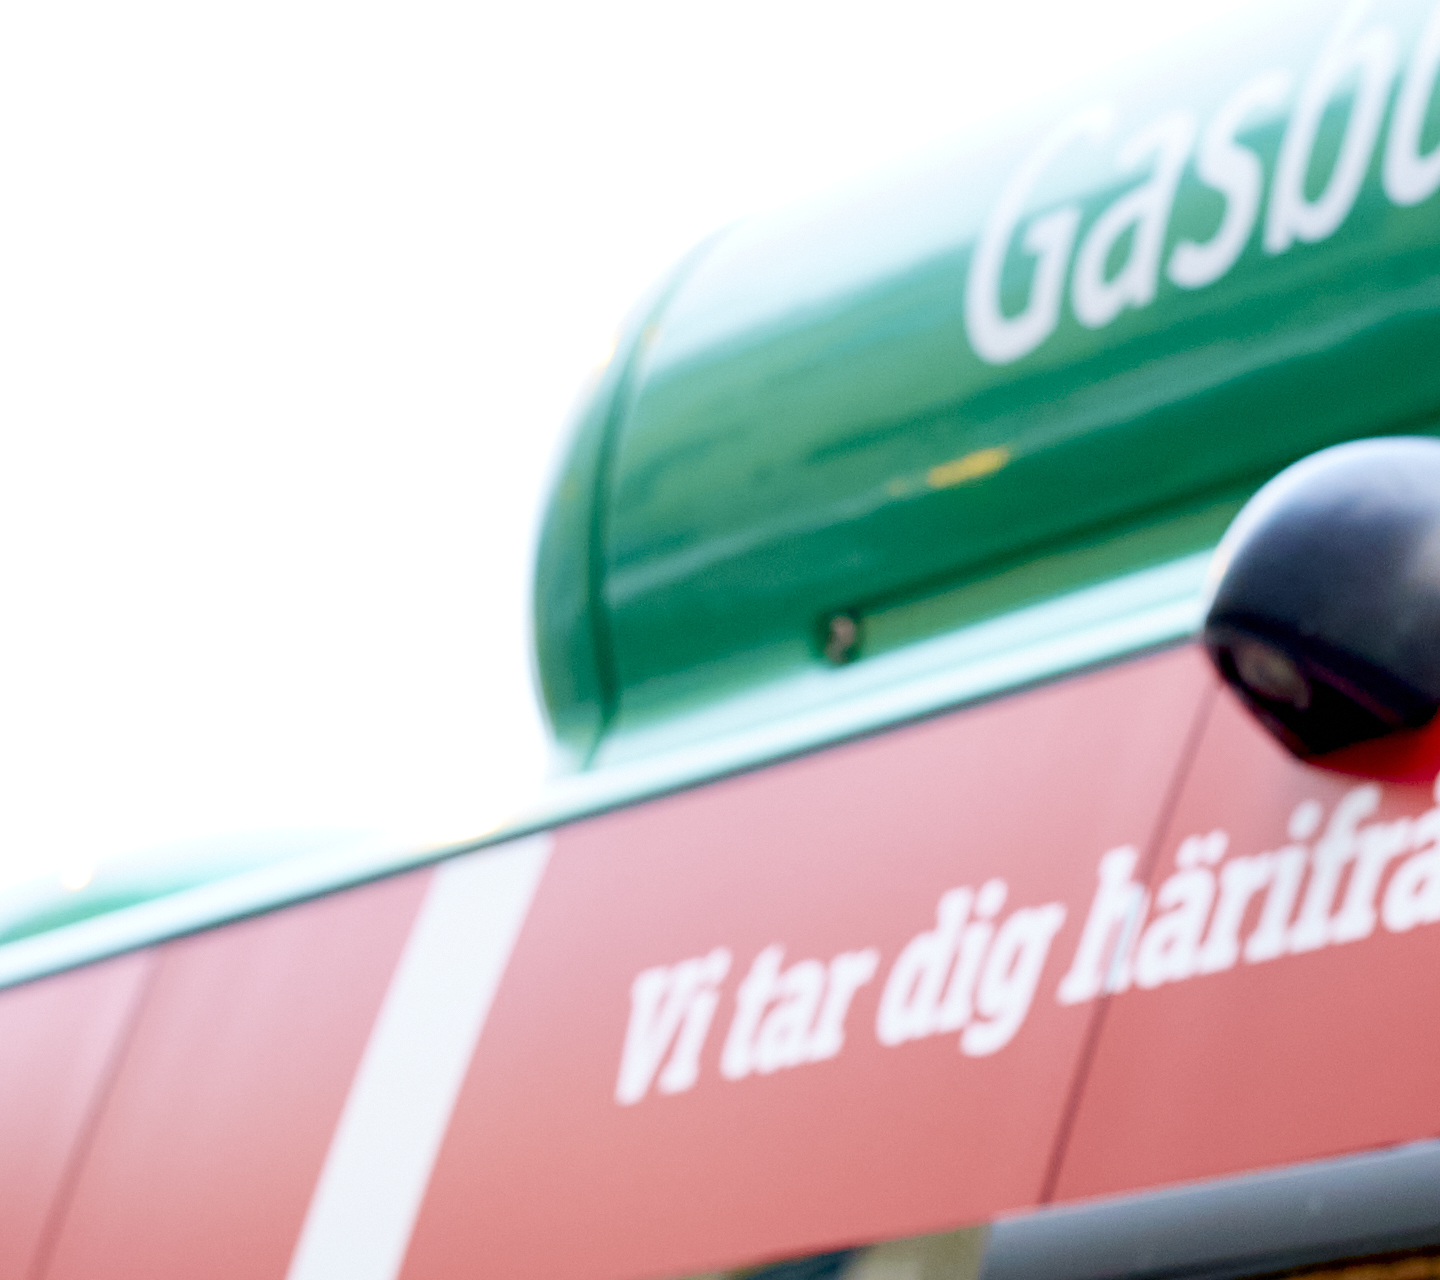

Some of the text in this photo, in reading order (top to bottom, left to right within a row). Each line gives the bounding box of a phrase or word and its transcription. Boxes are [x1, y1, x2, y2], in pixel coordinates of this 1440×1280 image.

[615, 946, 731, 1104] Vi
[722, 947, 880, 1079] tar
[877, 880, 1064, 1056] dig
